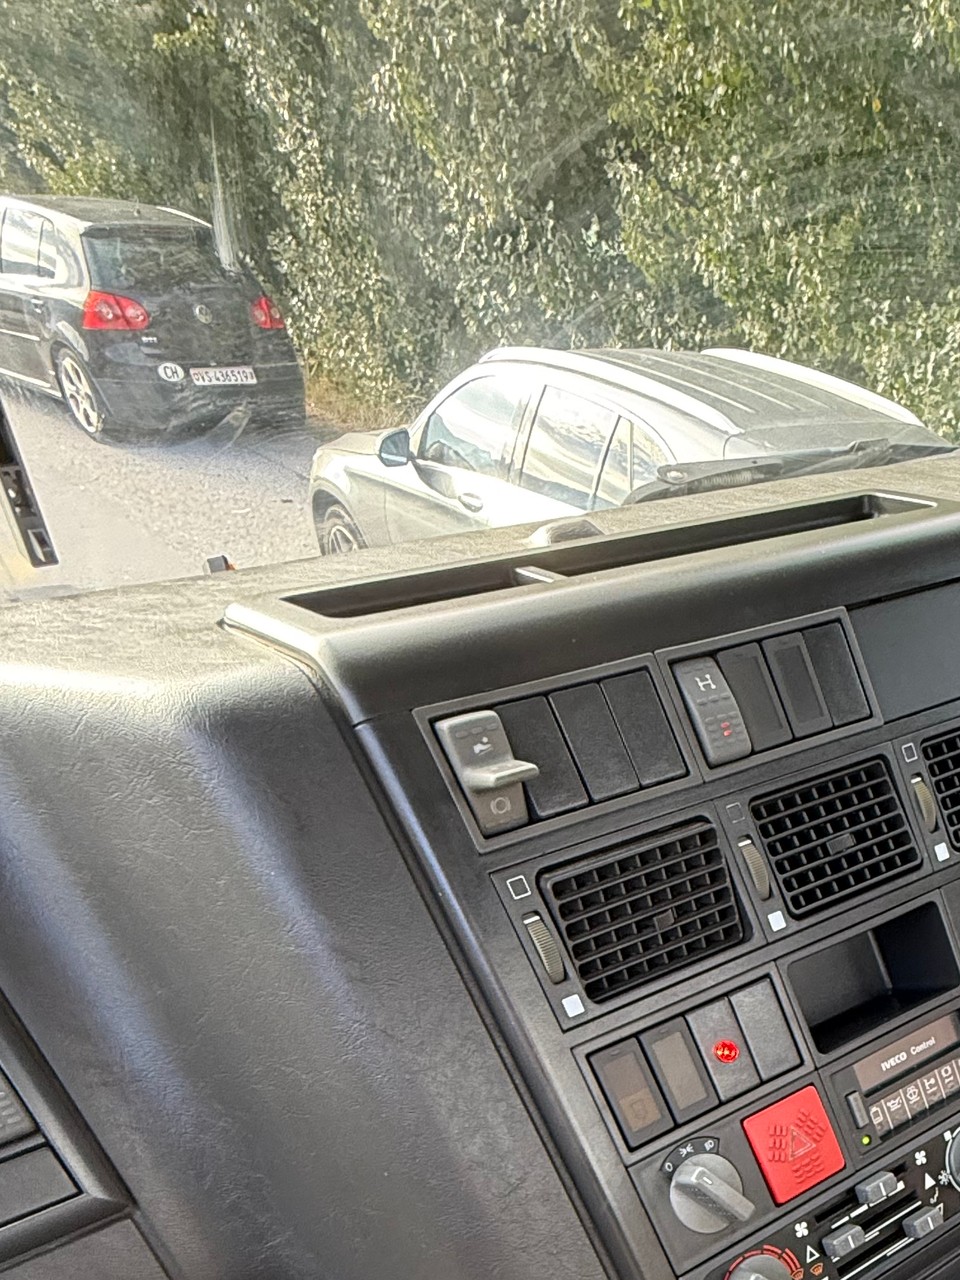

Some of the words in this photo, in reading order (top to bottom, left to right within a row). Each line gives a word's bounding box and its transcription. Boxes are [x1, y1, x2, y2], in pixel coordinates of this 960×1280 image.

[163, 365, 181, 379] CH
[880, 1051, 908, 1072] IVECO
[910, 1036, 936, 1055] Control
